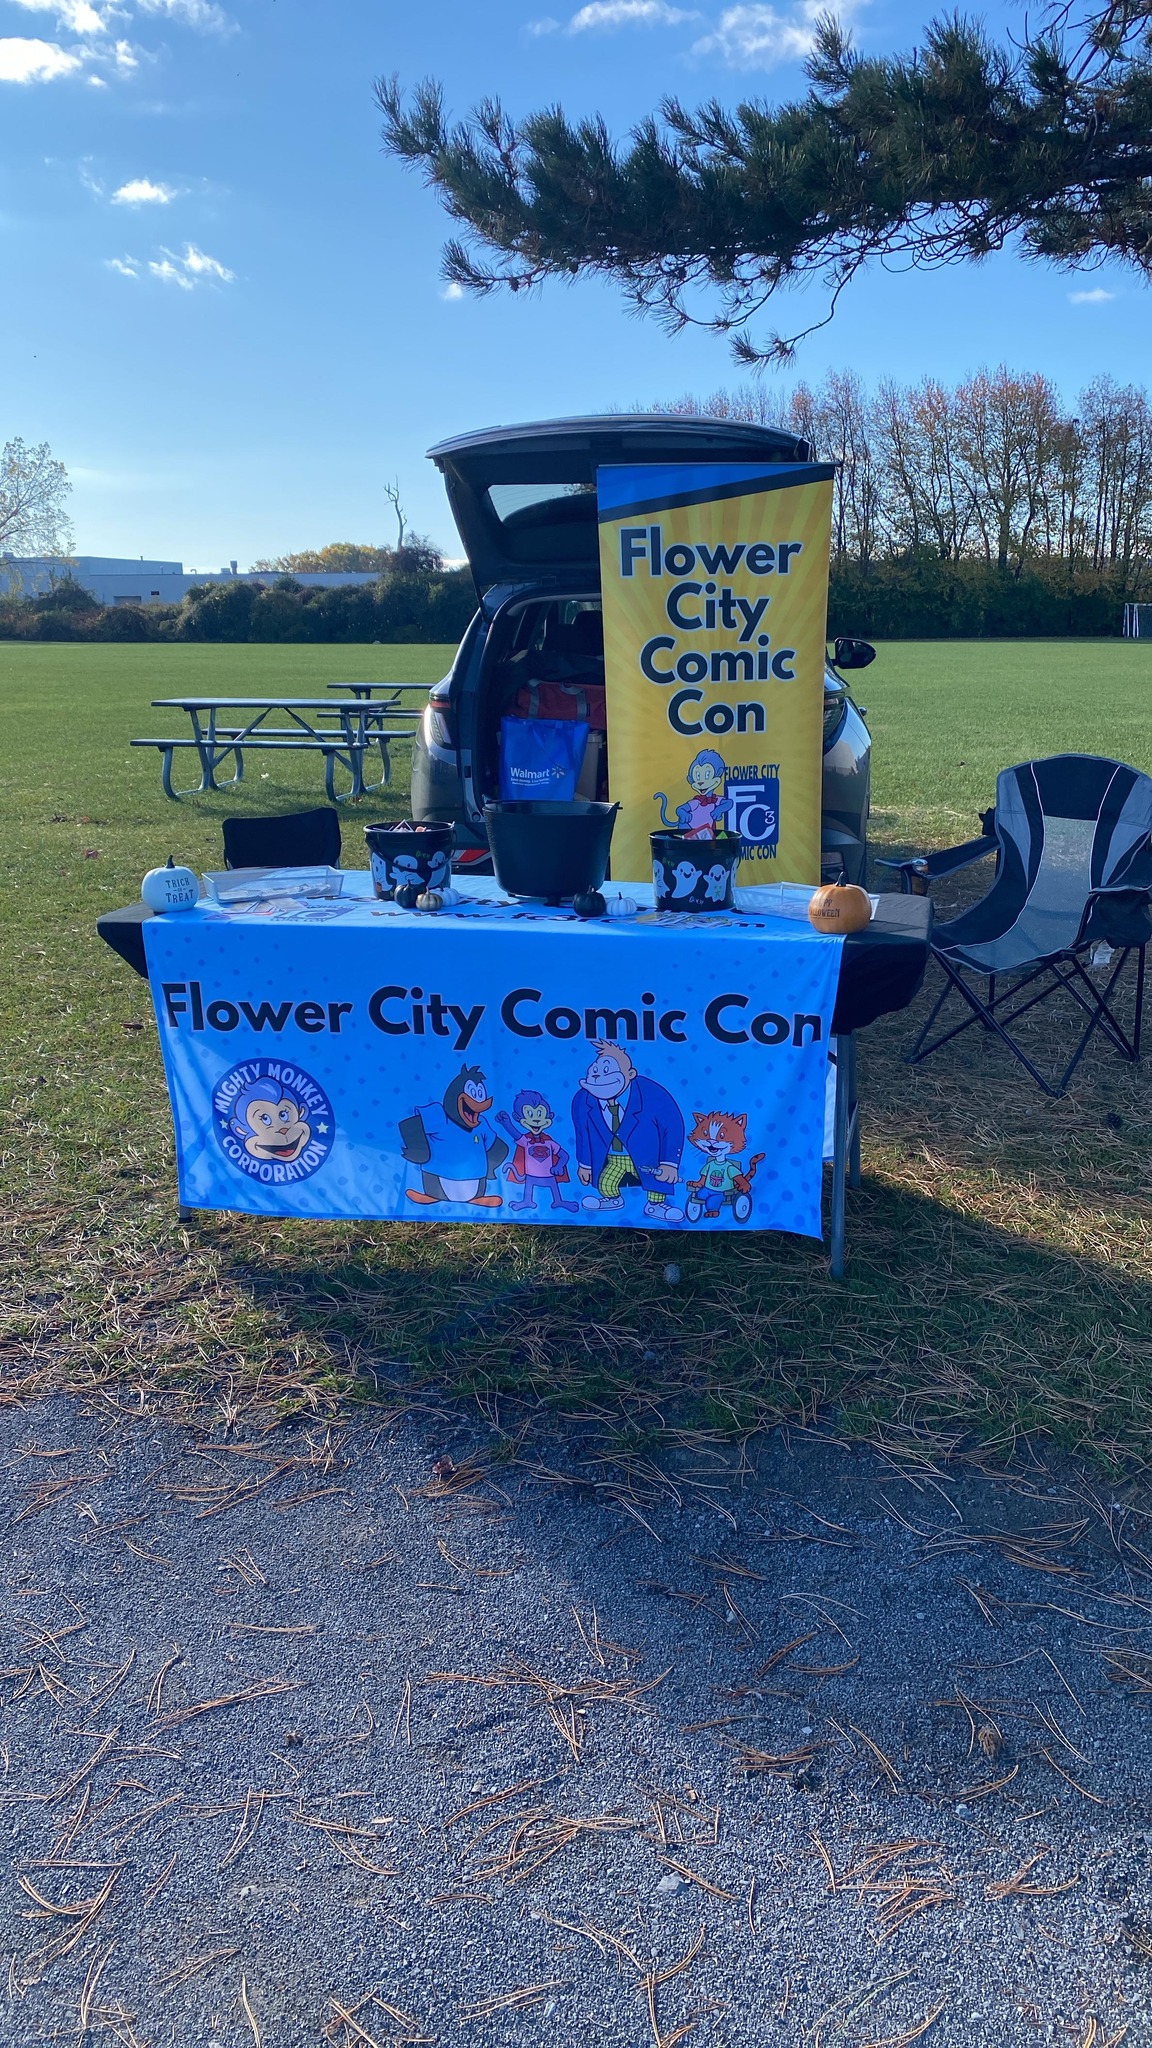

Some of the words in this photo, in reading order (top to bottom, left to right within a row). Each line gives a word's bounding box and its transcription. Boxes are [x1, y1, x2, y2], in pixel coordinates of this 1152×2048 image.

[620, 526, 801, 577] Flower
[667, 582, 769, 641] City
[640, 636, 796, 684] Comic
[667, 689, 765, 735] Con
[510, 767, 550, 779] Walmart
[725, 765, 758, 780] FLOWER
[761, 764, 780, 779] CITY
[740, 846, 754, 860] MIC
[757, 845, 776, 860] CON
[165, 877, 190, 889] TRICK
[165, 889, 194, 903] TREAT
[161, 981, 353, 1034] Flower
[368, 985, 485, 1051] City
[500, 987, 687, 1042] Comic
[704, 994, 822, 1047] Con
[215, 1063, 260, 1114] MIGHTY
[267, 1063, 329, 1116] MONKEY
[222, 1135, 328, 1182] CORPORATION
